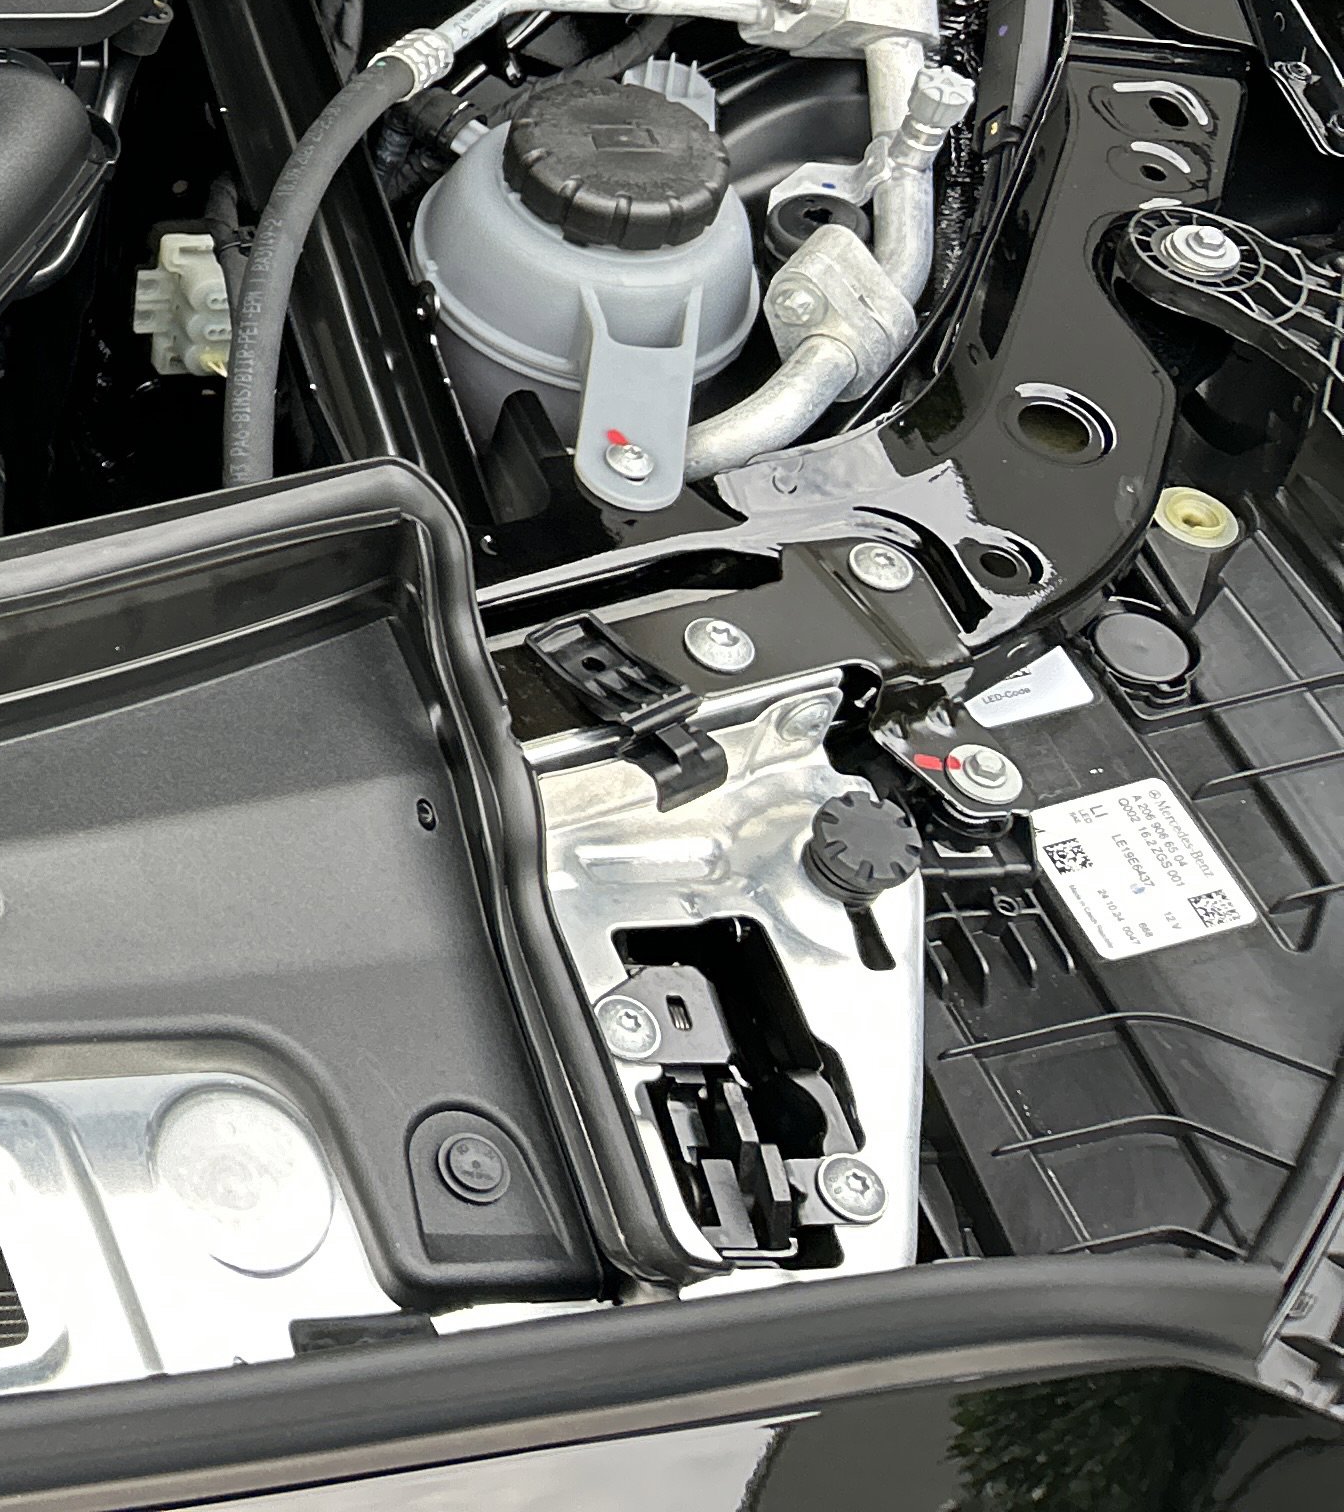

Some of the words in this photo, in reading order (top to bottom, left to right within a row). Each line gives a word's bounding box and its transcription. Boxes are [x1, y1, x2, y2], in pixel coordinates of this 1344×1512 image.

[981, 686, 1032, 705] LED-Code
[1132, 793, 1143, 803] A
[1137, 801, 1157, 821] 206
[1151, 820, 1170, 841] 906
[1154, 798, 1215, 880] Mercedes-Benz
[1118, 795, 1142, 824] Q002
[1151, 845, 1173, 871] ZGS
[1167, 868, 1186, 889] 001
[1164, 839, 1179, 854] 65
[1174, 853, 1188, 868] 04
[1163, 910, 1176, 923] 12
[1171, 921, 1181, 932] V
